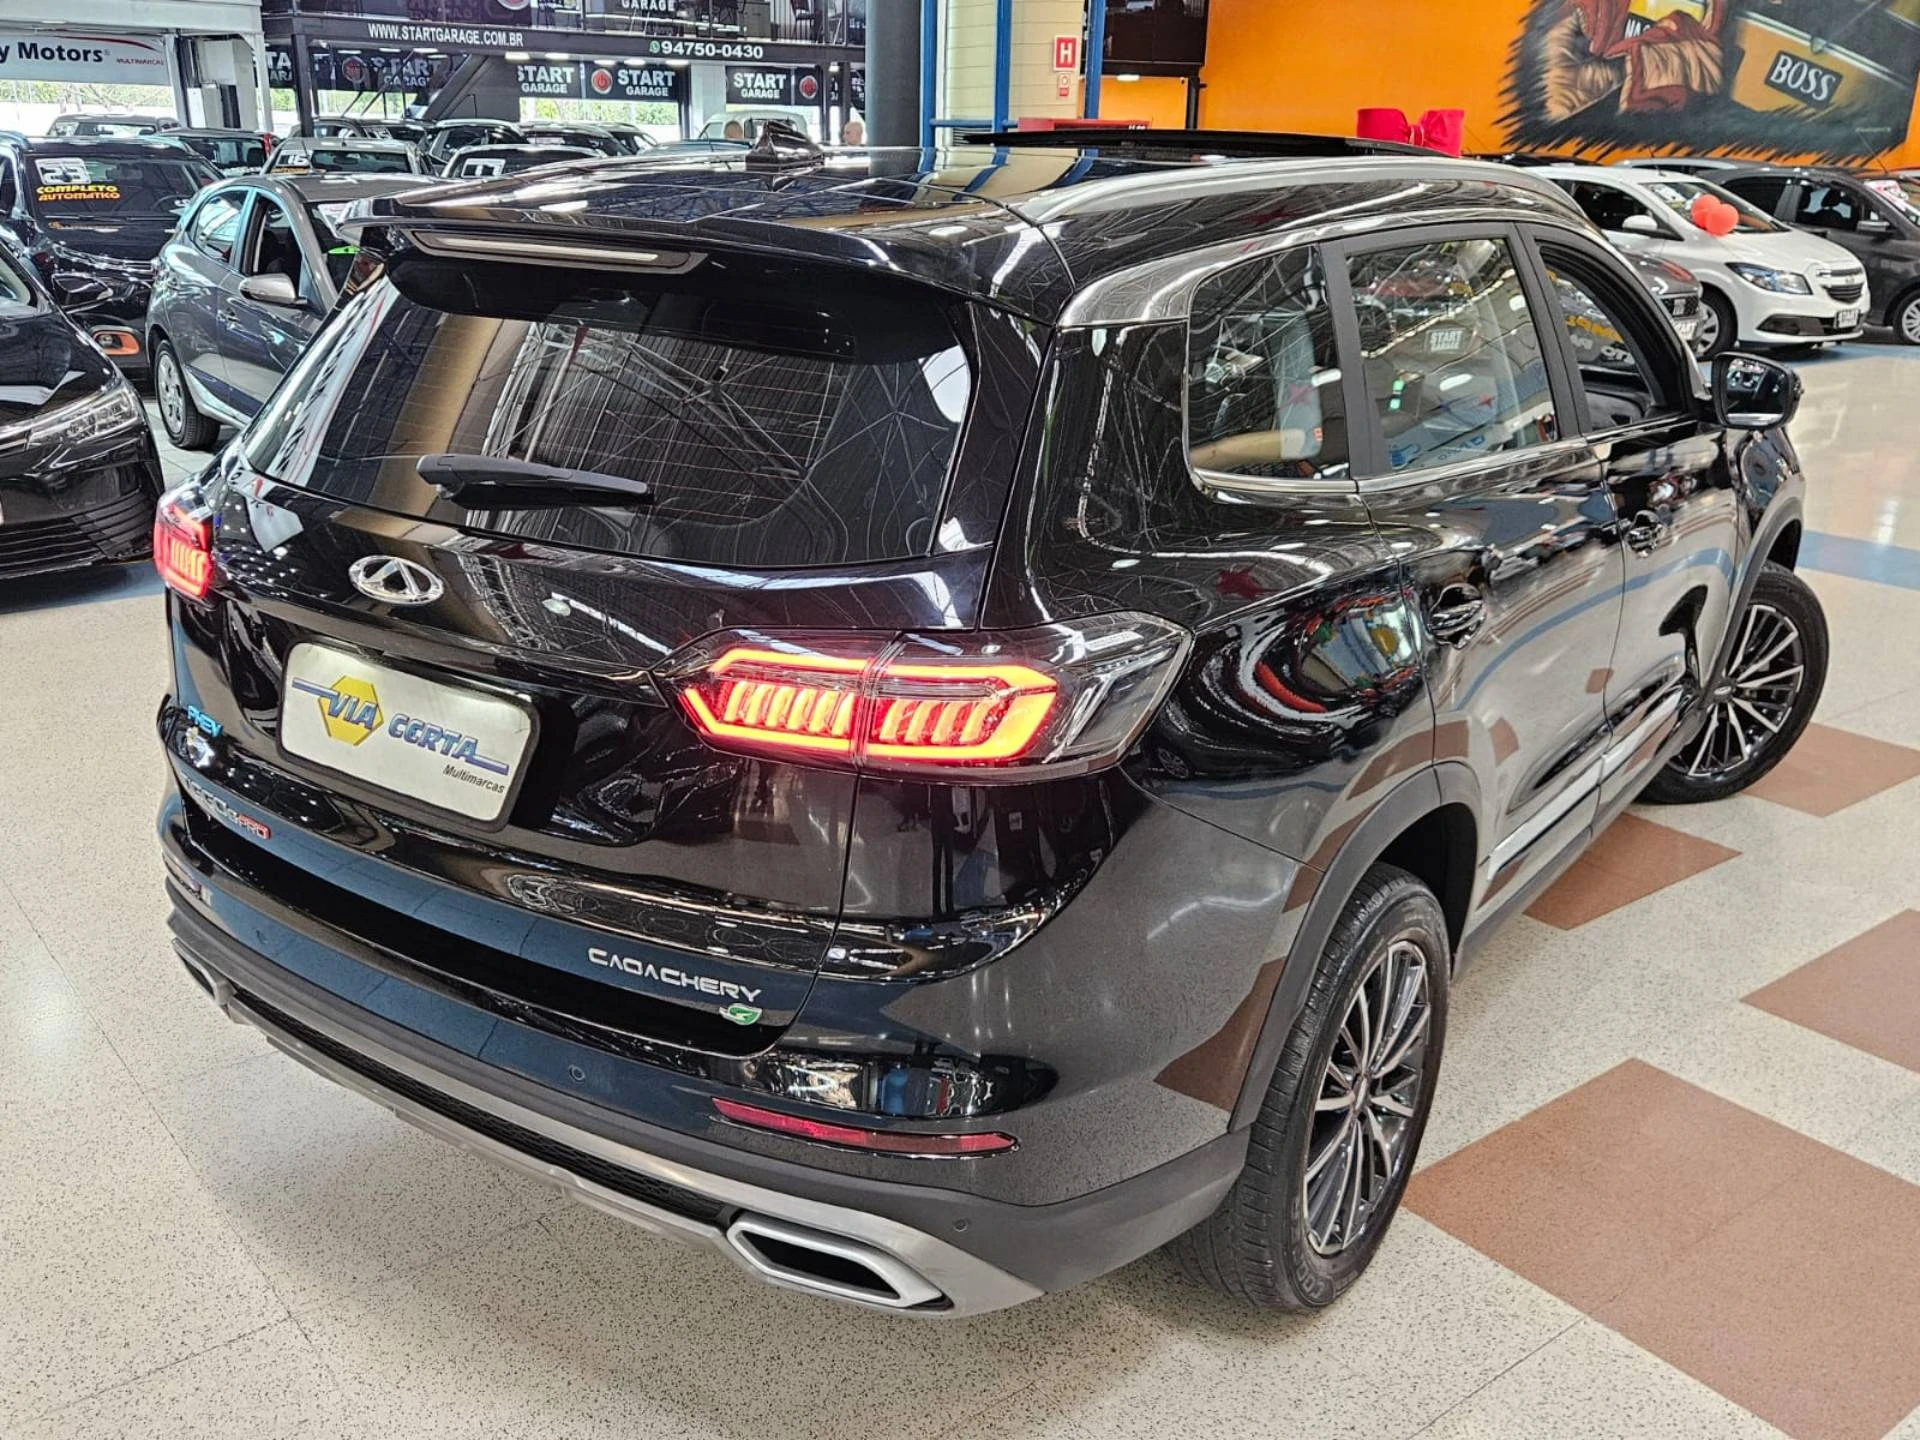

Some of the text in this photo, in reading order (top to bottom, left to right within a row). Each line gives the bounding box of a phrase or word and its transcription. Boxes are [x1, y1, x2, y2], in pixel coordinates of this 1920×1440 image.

[368, 23, 524, 47] WWW.STARTGARAGE.COM.BR
[17, 41, 103, 63] Motors
[661, 40, 763, 59] 94750-0430
[1060, 42, 1073, 64] H
[518, 65, 574, 83] START
[617, 69, 675, 87] START
[733, 72, 787, 90] START
[1769, 54, 1837, 102] BOSS
[521, 83, 568, 94] GARAGE
[626, 86, 669, 97] GARAGE
[741, 87, 781, 99] GARAGE
[36, 184, 119, 194] COMPLETO
[328, 690, 478, 764] VIA CERTA
[443, 764, 506, 794] Multimarcas
[588, 947, 762, 1003] CAOACHERY
